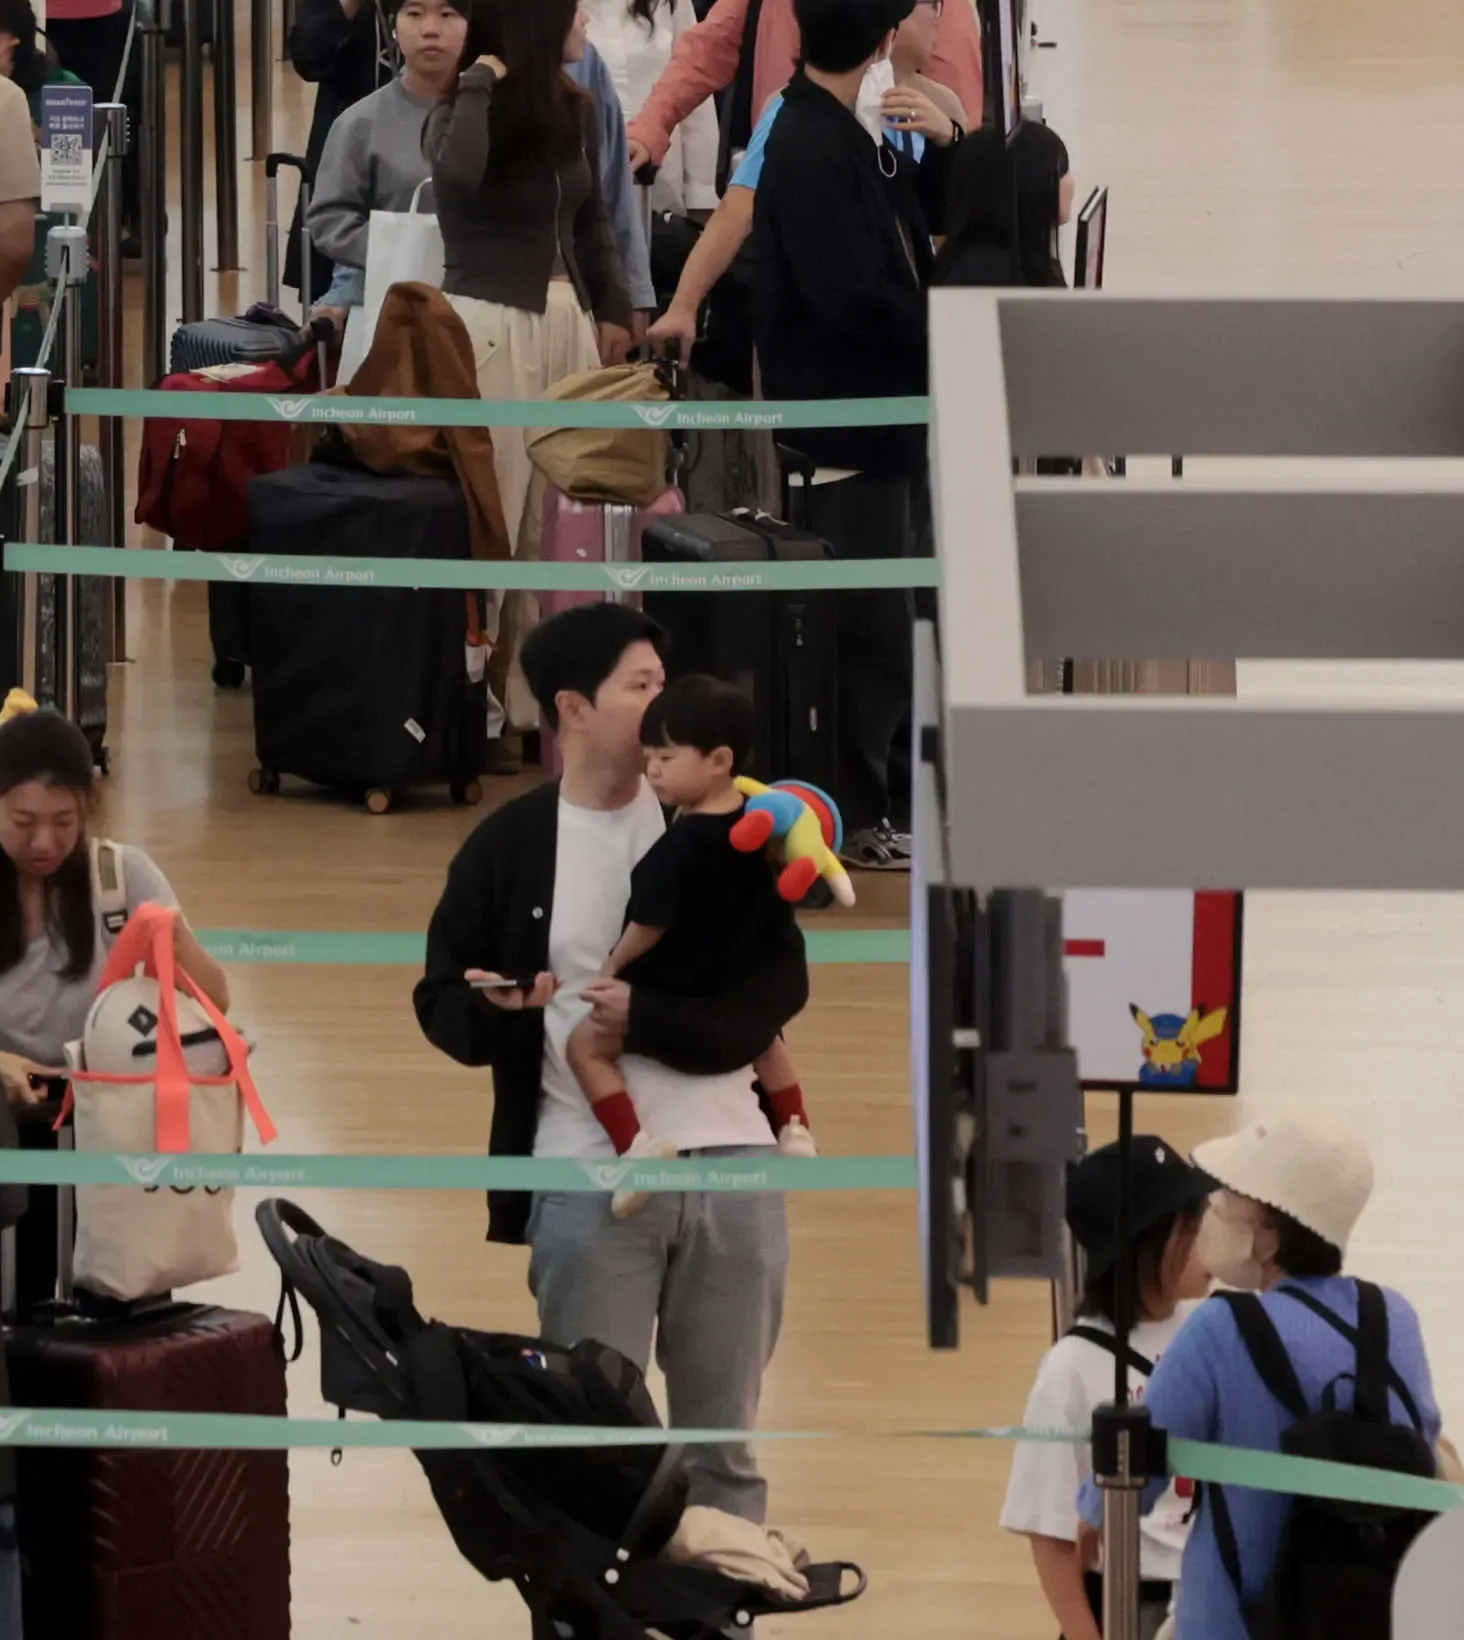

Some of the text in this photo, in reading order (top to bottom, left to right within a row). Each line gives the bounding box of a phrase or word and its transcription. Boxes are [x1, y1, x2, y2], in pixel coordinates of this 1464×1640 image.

[312, 406, 415, 421] Incheon Airport
[676, 411, 783, 426] Incheon Airport
[265, 566, 375, 582] Incheon Airport
[650, 572, 762, 587] Incheon Airport
[172, 1166, 305, 1183] Incheon Airport
[634, 1171, 768, 1188] Incheon Airport
[26, 1424, 169, 1441] Incheon Airport
